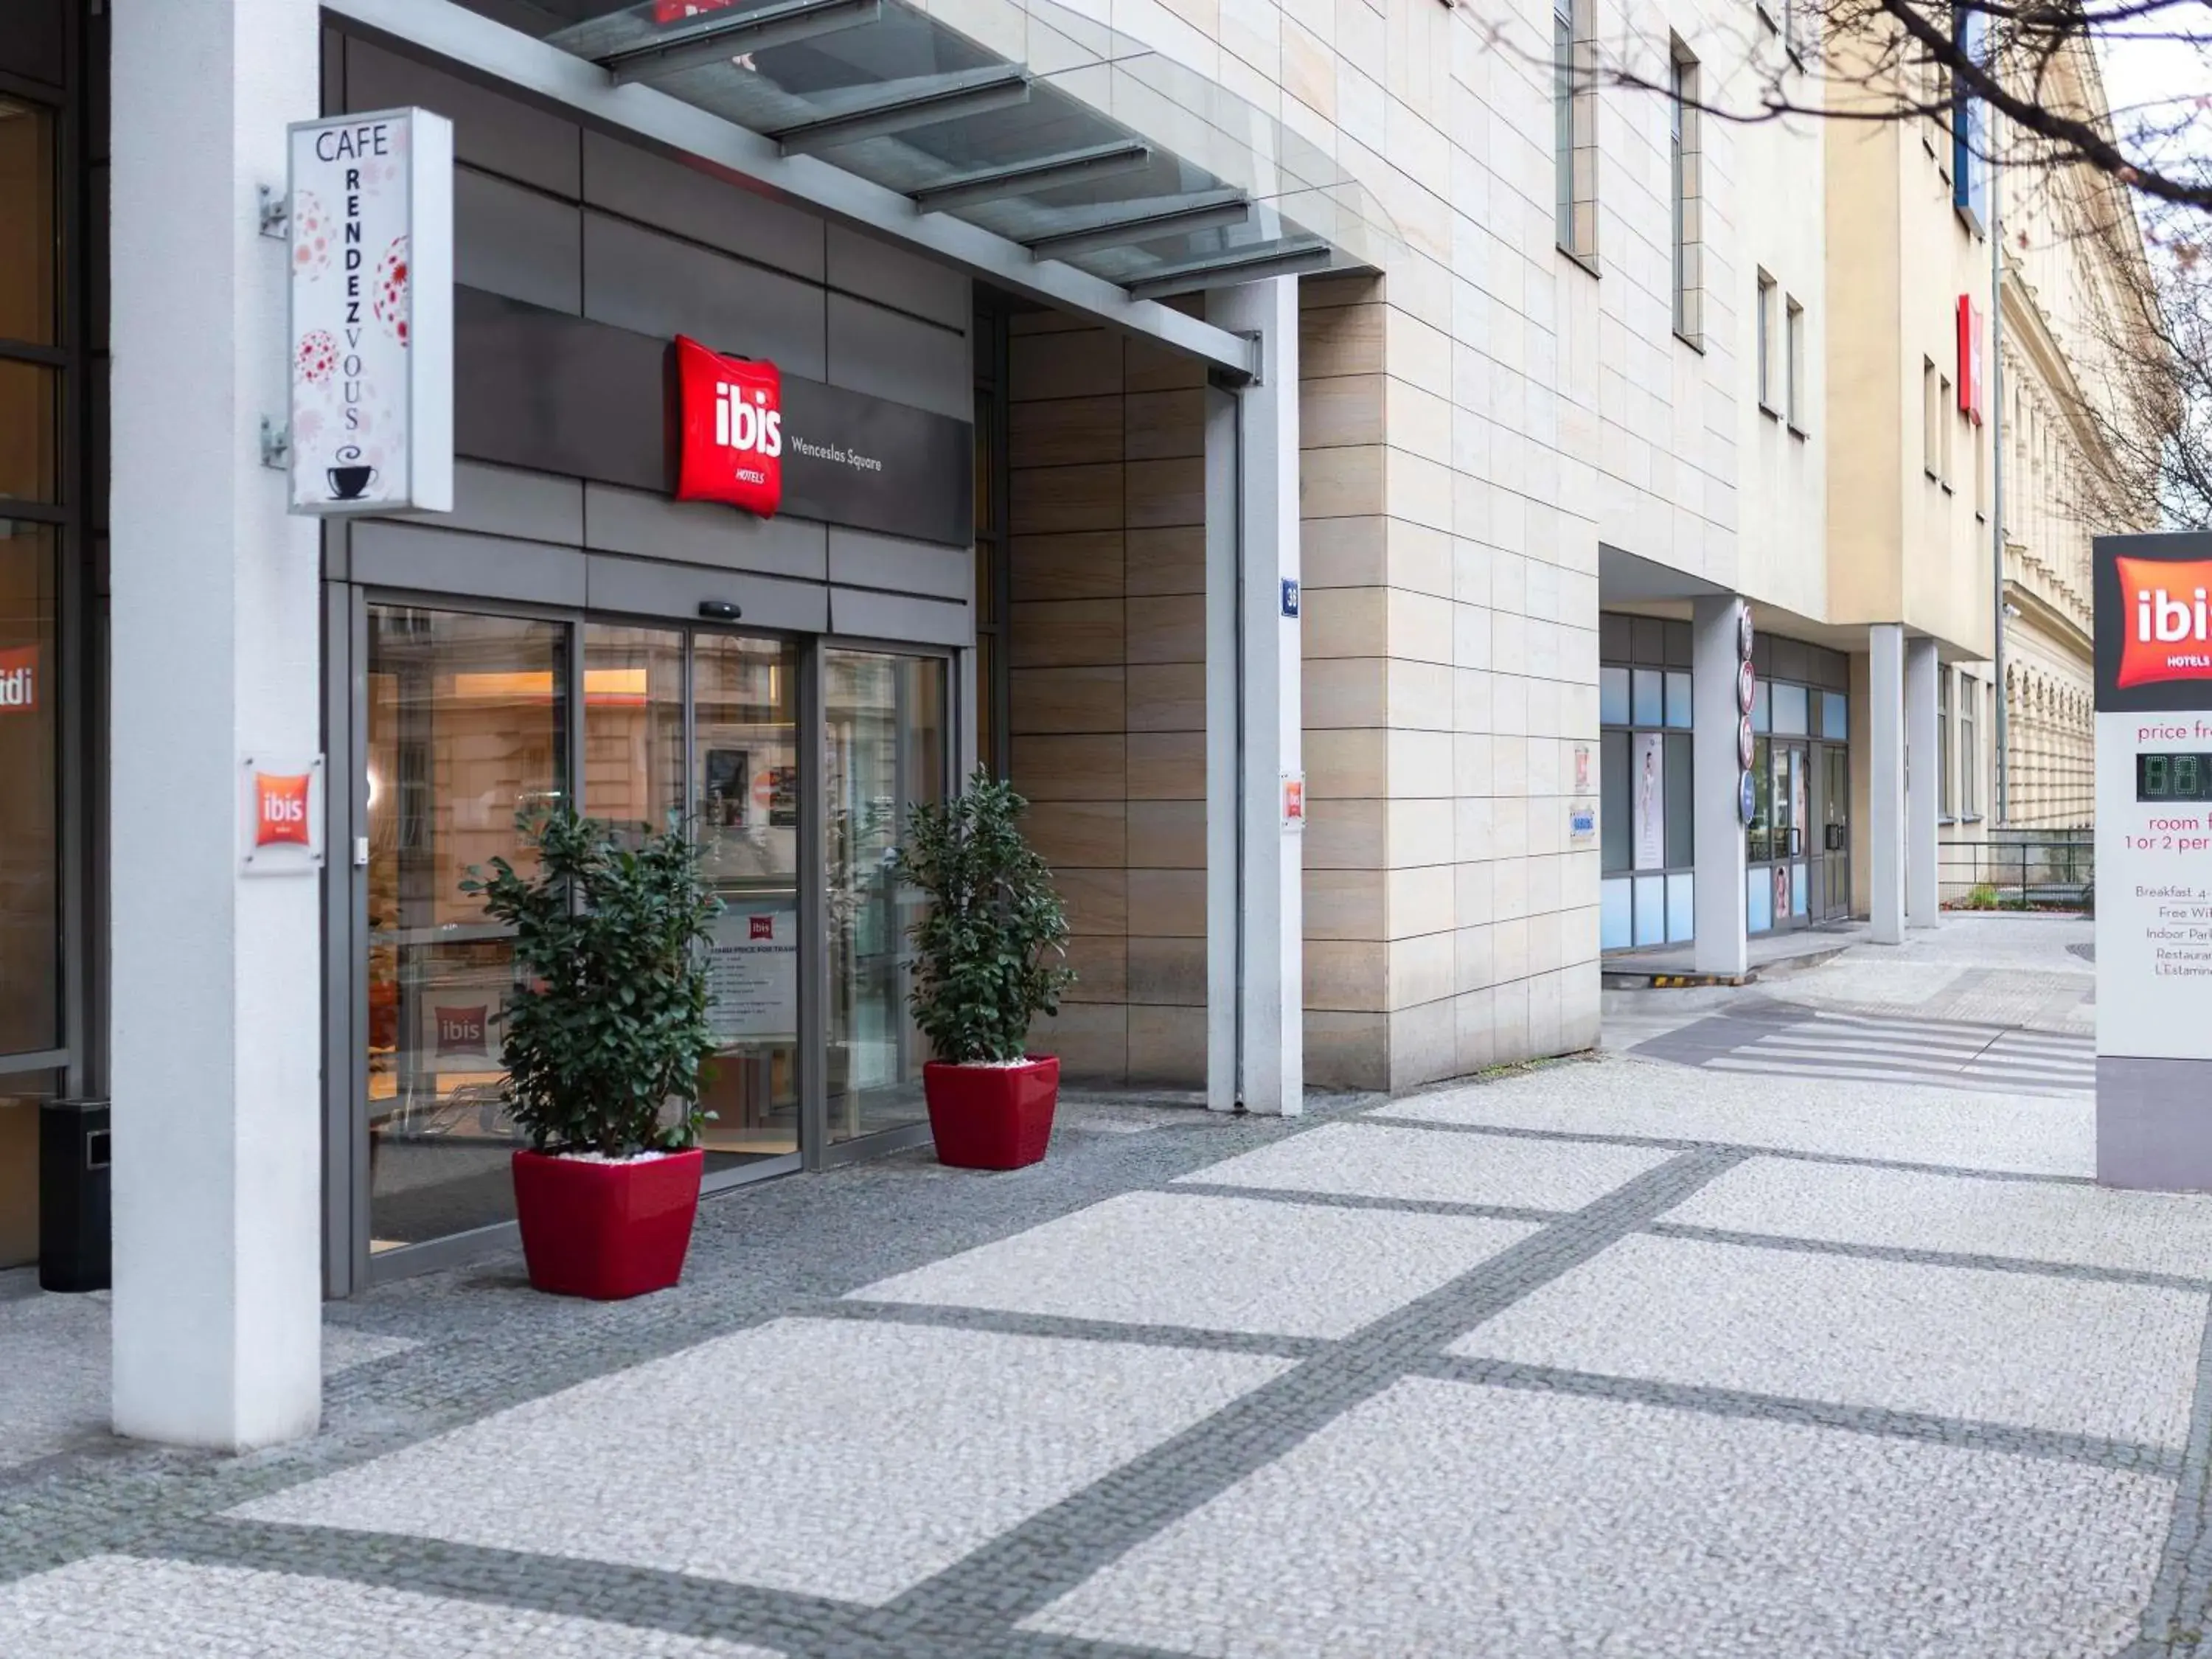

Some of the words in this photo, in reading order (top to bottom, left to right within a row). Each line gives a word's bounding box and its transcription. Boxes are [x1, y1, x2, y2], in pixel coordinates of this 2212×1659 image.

[316, 125, 388, 162] CAFE
[716, 381, 782, 458] ibis
[791, 436, 846, 464] Wenceslas
[847, 448, 883, 472] Square
[735, 468, 765, 484] HOTELS
[2138, 587, 2212, 642] ibi
[2167, 655, 2211, 667] HOTELS
[2138, 723, 2187, 743] price
[264, 791, 304, 821] ibis
[2149, 818, 2199, 830] room
[2162, 836, 2171, 849] 2
[2135, 885, 2192, 897] Breakfast
[2159, 906, 2187, 918] Free
[752, 922, 770, 933] ibis
[2146, 927, 2185, 939] Indoor
[443, 1019, 480, 1040] ibis
